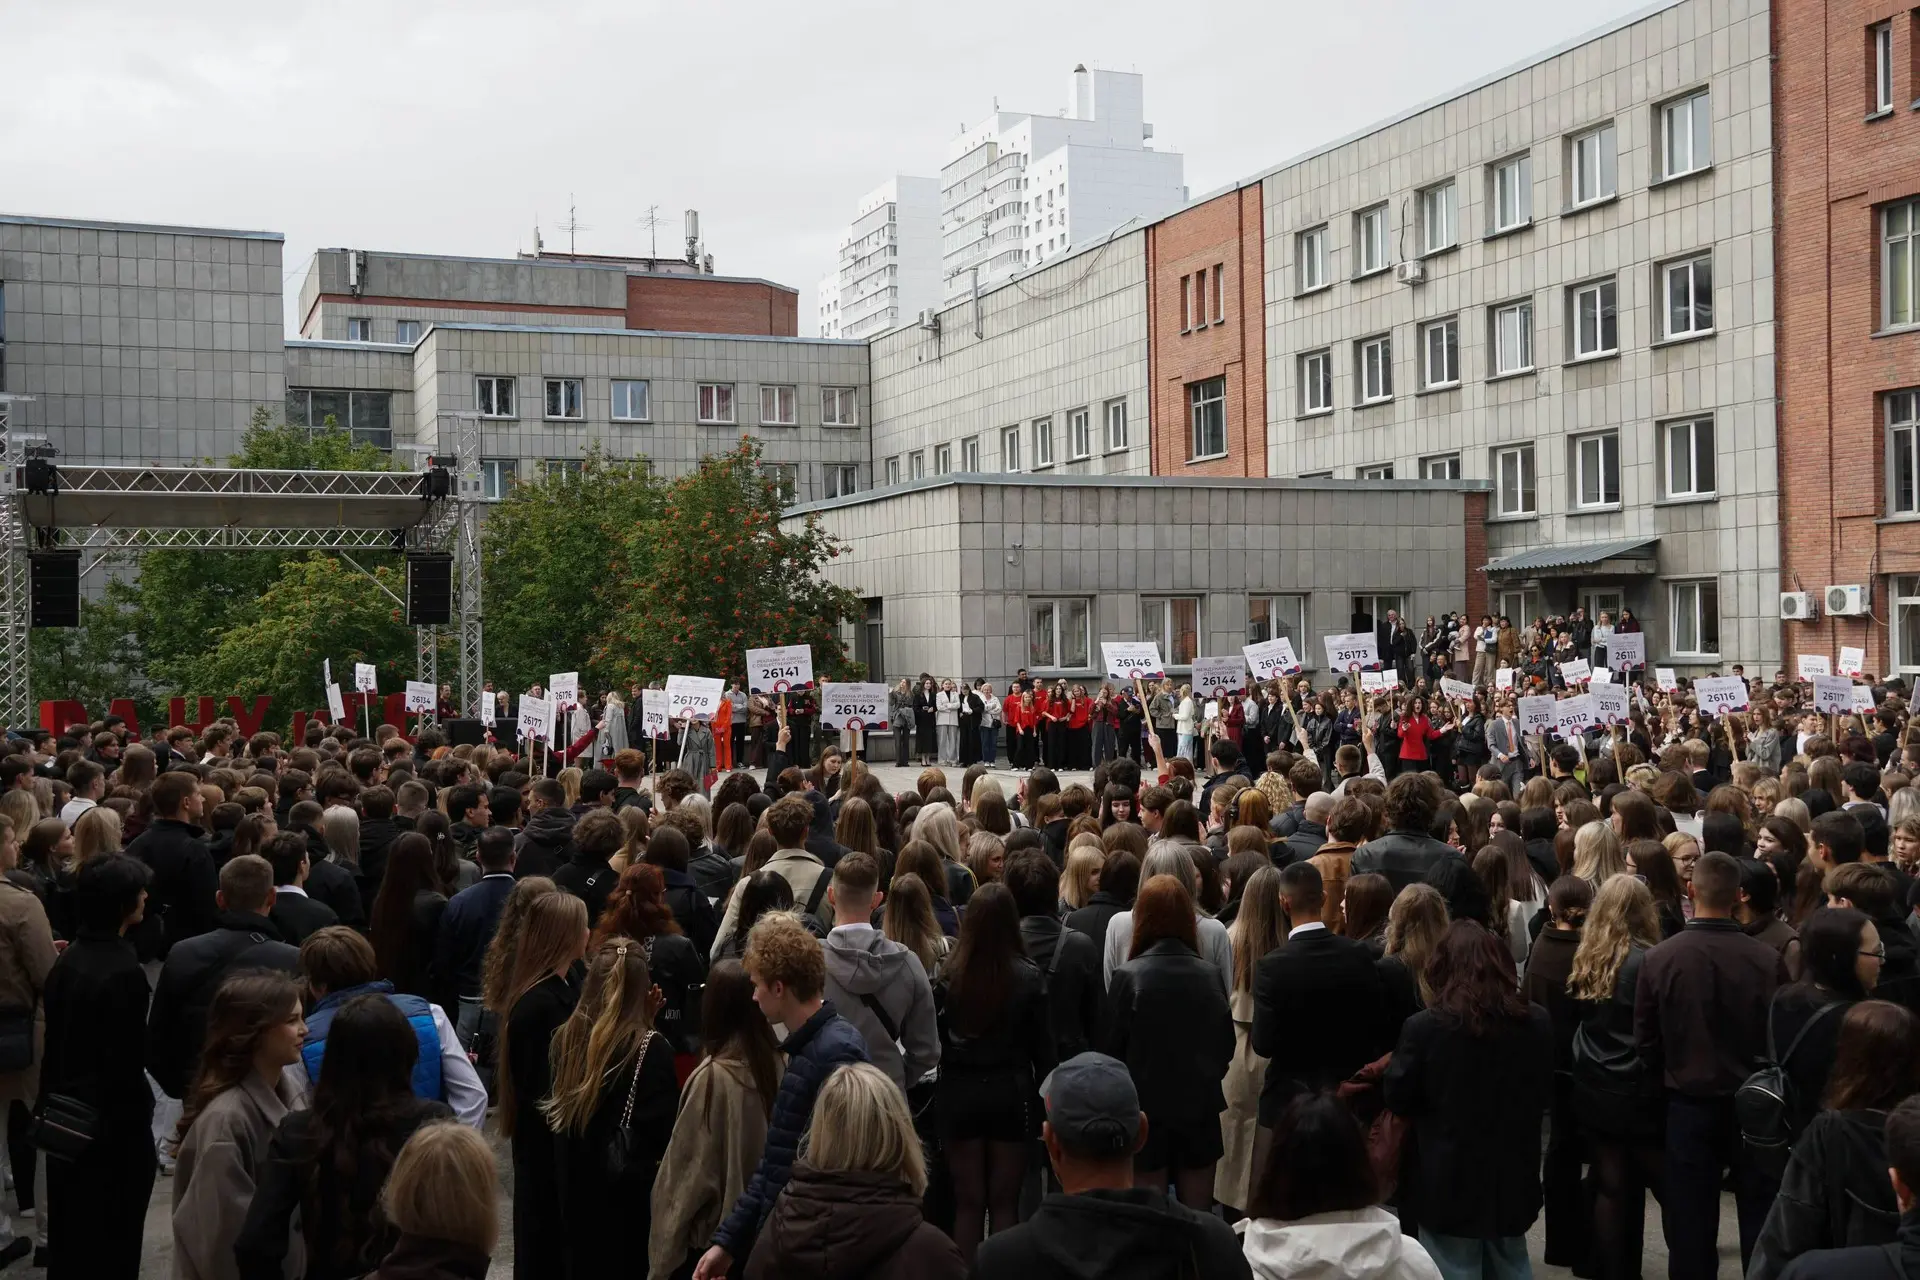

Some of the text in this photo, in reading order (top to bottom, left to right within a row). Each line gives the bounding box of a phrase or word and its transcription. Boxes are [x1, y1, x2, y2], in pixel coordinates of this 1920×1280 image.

[1337, 650, 1368, 660] 26173
[1615, 651, 1637, 660] 26111
[1115, 658, 1152, 667] 26146
[1259, 656, 1289, 669] 26143
[762, 666, 799, 679] 26141
[1202, 675, 1237, 686] 26144
[555, 690, 573, 701] 26176
[672, 694, 709, 707] 26178
[1707, 692, 1736, 703] 26116
[1823, 691, 1845, 702] 26117
[834, 704, 877, 715] 26142
[1600, 700, 1621, 711] 26119
[523, 714, 543, 728] 26177
[1528, 713, 1550, 724] 26113
[1559, 713, 1589, 727] 26112
